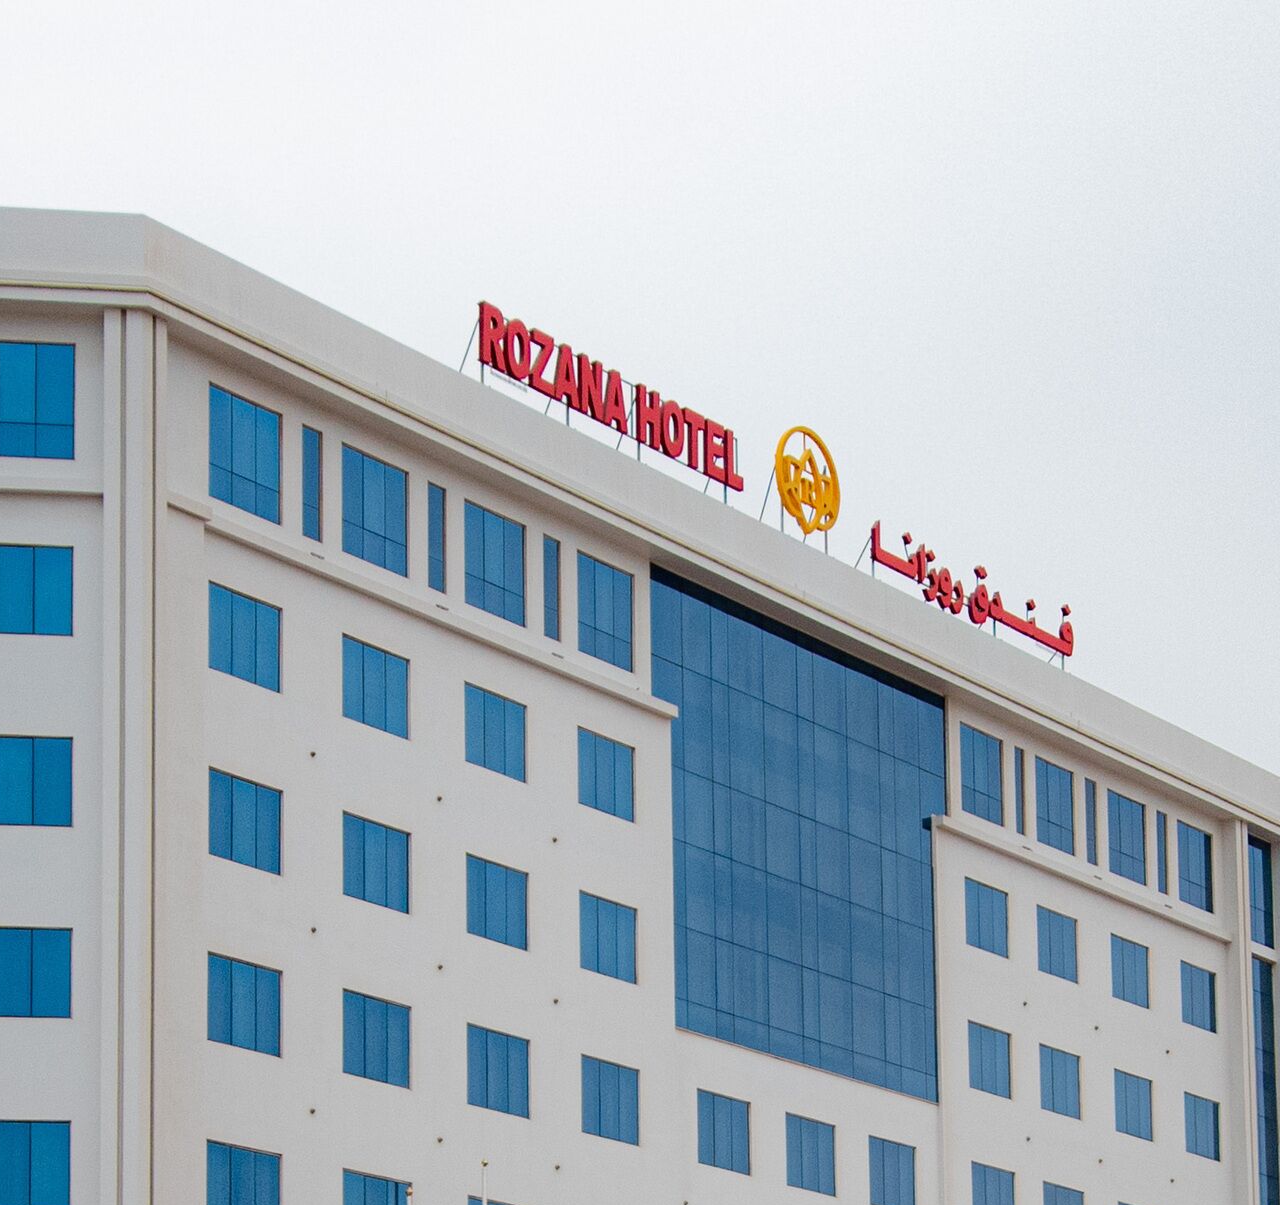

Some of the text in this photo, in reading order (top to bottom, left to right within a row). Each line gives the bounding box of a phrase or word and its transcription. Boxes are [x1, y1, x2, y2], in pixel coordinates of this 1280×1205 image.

[478, 301, 744, 492] ROZANA HOTEL
[871, 520, 1074, 657] فندق روزانا
